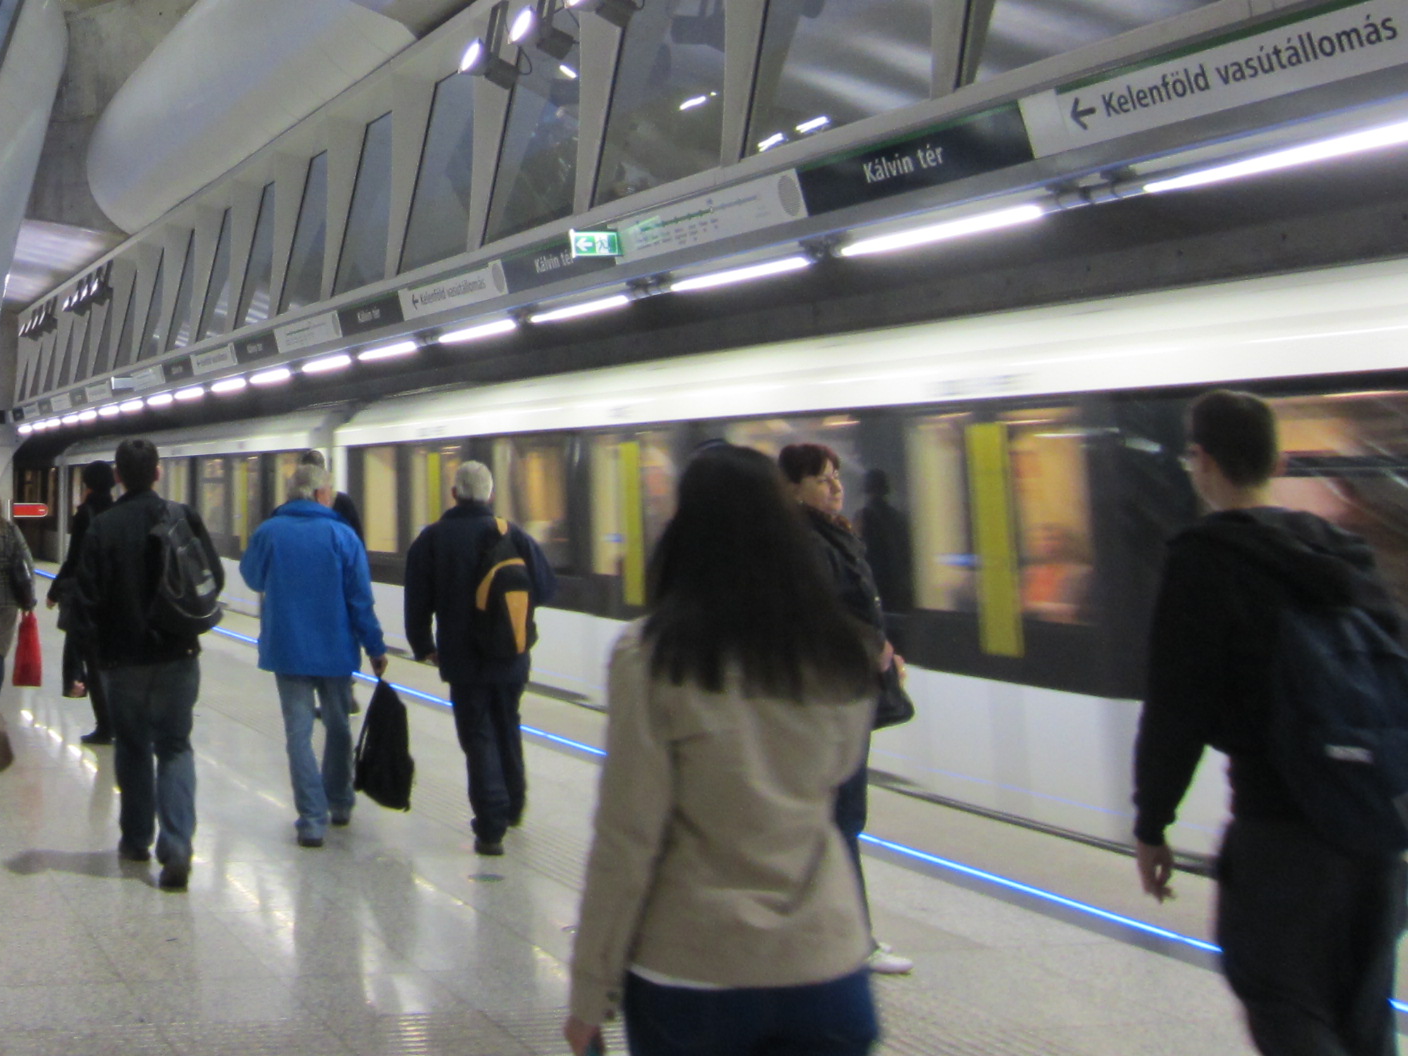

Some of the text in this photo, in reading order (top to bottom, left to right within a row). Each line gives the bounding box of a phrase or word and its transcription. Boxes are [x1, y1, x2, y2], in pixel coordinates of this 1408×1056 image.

[1101, 13, 1399, 118] Kelenföld vasútállomás
[862, 143, 944, 184] Kálvin tér
